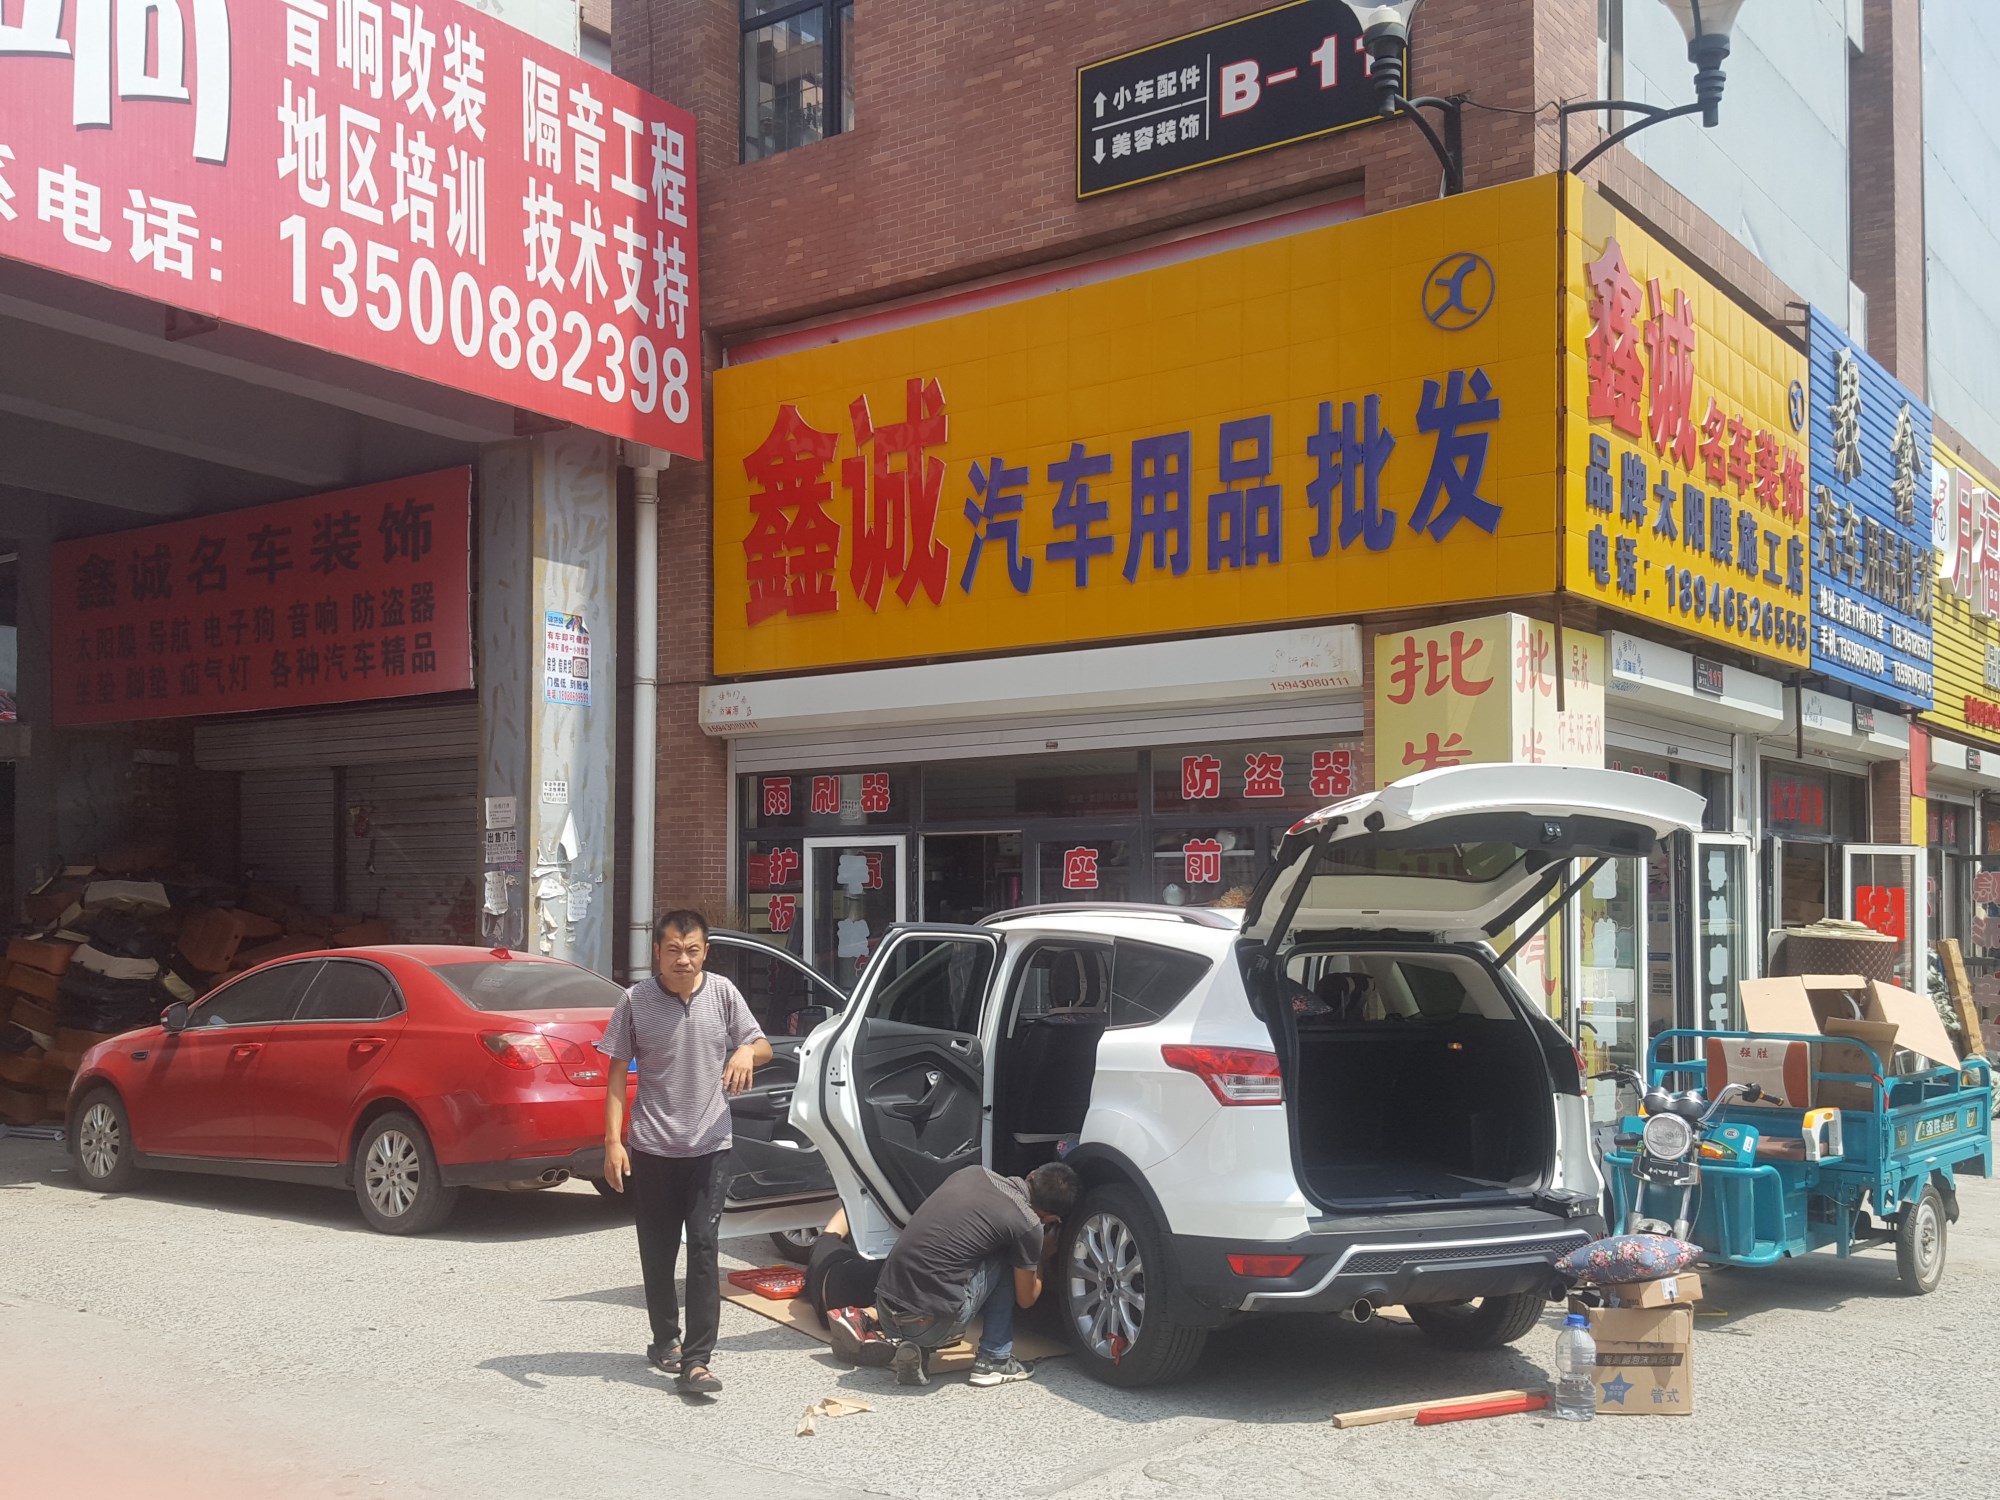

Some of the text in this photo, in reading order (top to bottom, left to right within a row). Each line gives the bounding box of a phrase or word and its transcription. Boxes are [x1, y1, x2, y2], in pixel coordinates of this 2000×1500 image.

[281, 0, 688, 229] 音响改装 隔音工程
[1113, 64, 1201, 111] 小车配件
[1111, 112, 1200, 160] 美容装饰
[277, 78, 689, 340] 地区培训 技术支持
[279, 213, 690, 424] 13500882398
[1585, 236, 1806, 525] 鑫诚 名车装饰
[743, 366, 1504, 627] 鑫诚 汽车用品批发
[1586, 433, 1805, 596] 品牌太阳膜施工店
[75, 498, 435, 611] 鑫诚名车装饰
[76, 581, 436, 663] 太阳膜 导航 电子狗 音响 防盗器
[270, 631, 437, 690] 各种汽车精品
[1270, 677, 1350, 692] 15943080111
[1572, 644, 1589, 691] 导航
[763, 772, 890, 816] 雨刷器
[1181, 750, 1351, 800] 防盗器
[1062, 845, 1100, 891] 座
[1183, 838, 1222, 883] 前
[1651, 1388, 1680, 1404] 管式
